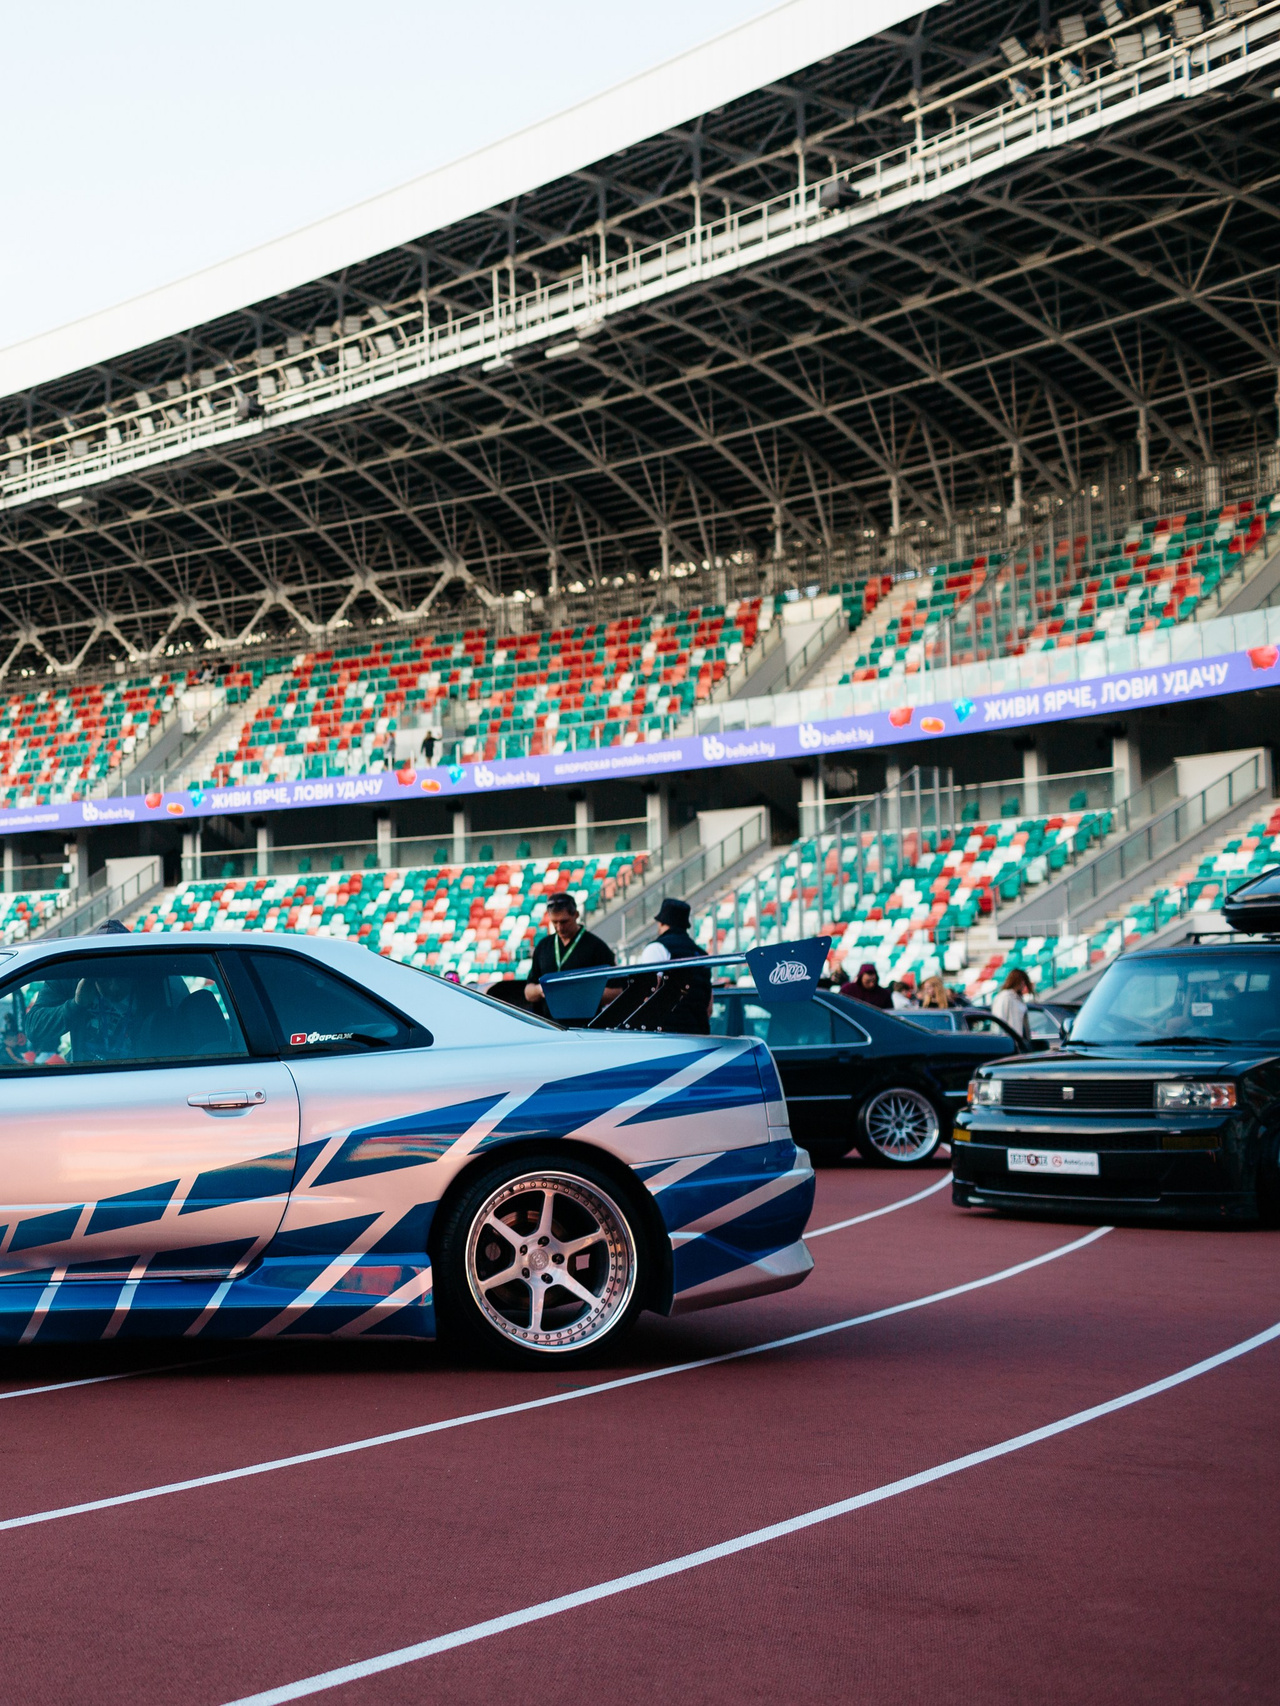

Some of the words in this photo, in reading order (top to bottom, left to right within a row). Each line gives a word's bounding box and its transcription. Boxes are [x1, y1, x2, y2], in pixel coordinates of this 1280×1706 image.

[984, 694, 1040, 722] ЖИВИ
[1043, 686, 1097, 712] ЯРЧЕ,
[1101, 675, 1157, 704] ЛОВИ
[1162, 662, 1229, 696] УДАЧУ
[822, 727, 874, 747] belbet.by
[725, 740, 776, 758] belbet.by
[495, 770, 540, 786] belbet.by
[211, 791, 251, 809] ЖИВИ
[253, 787, 291, 805] ЯРЧЕ,
[293, 783, 334, 801] ЛОВИ
[336, 779, 383, 799] УДАЧУ
